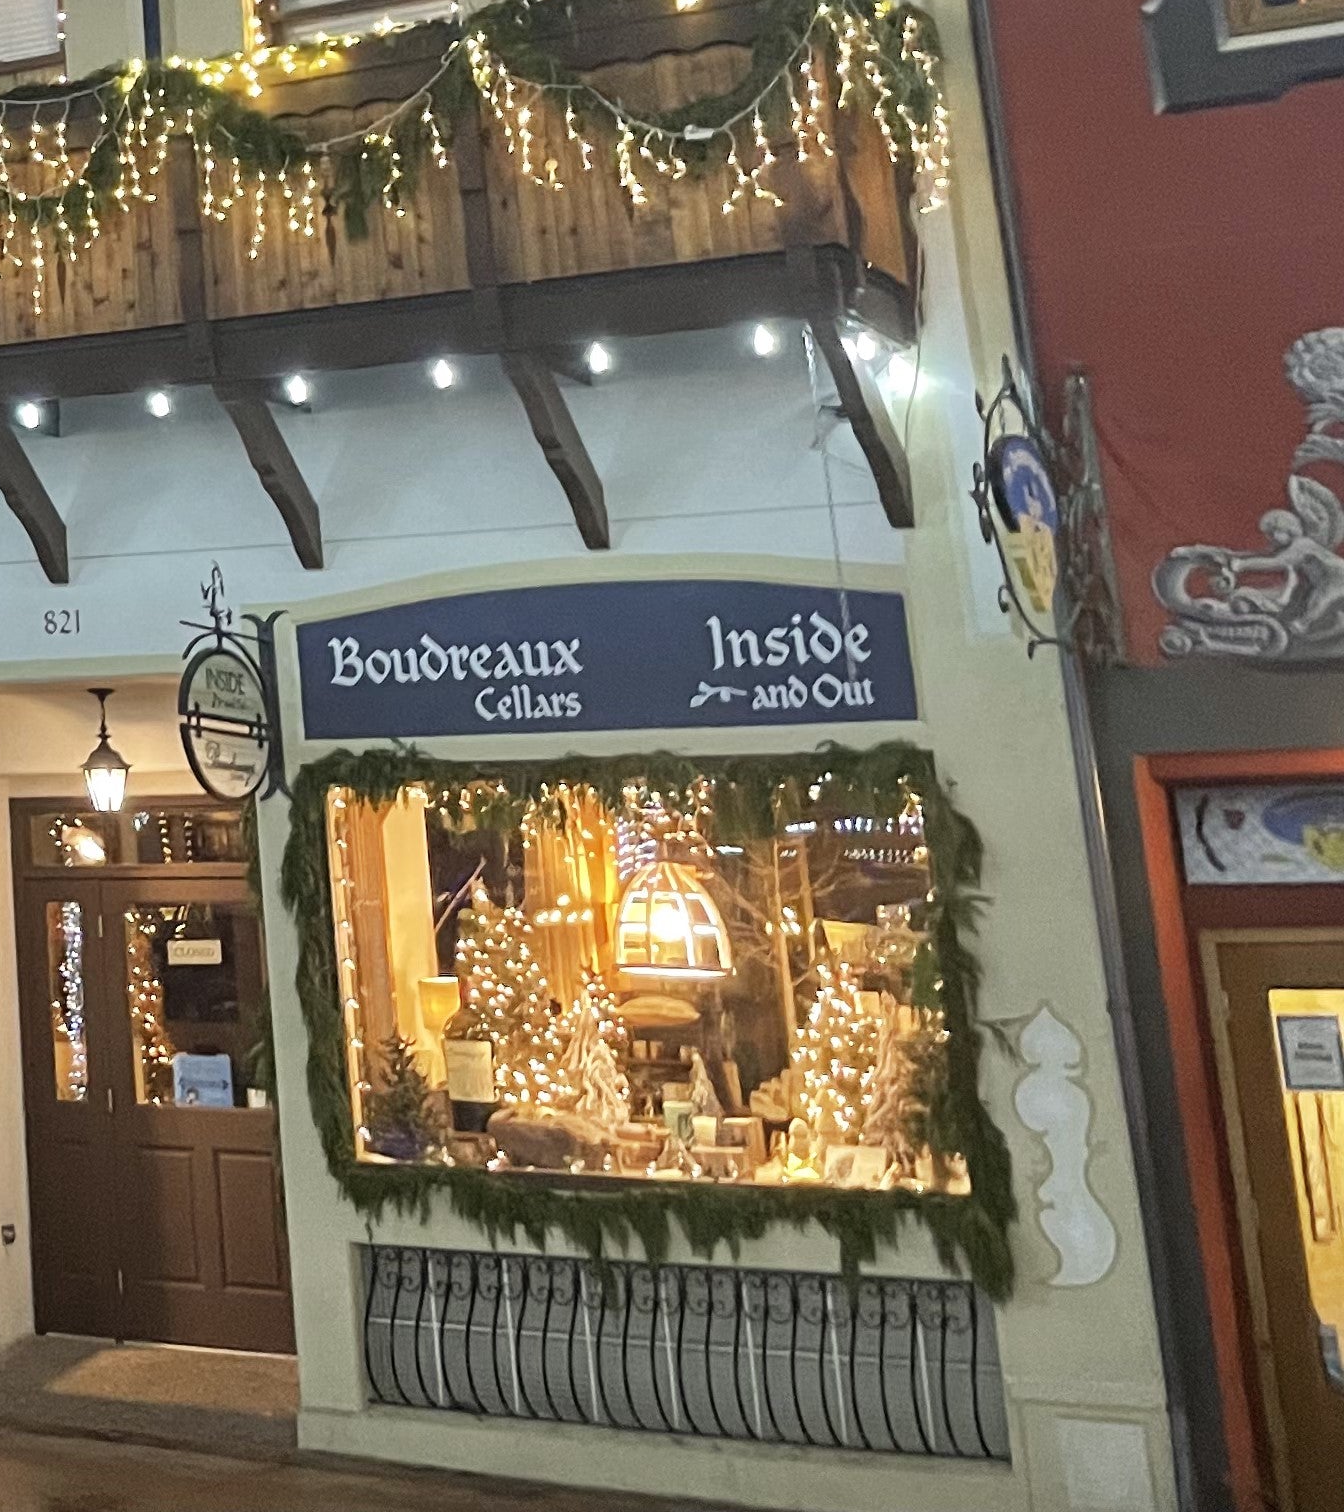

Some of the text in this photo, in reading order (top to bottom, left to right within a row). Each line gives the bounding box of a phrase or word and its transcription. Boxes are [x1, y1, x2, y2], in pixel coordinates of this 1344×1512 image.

[44, 609, 80, 635] 821
[705, 610, 872, 671] Inside
[328, 633, 584, 687] Boudreaux
[474, 684, 582, 721] Cellars
[752, 672, 876, 710] and Out
